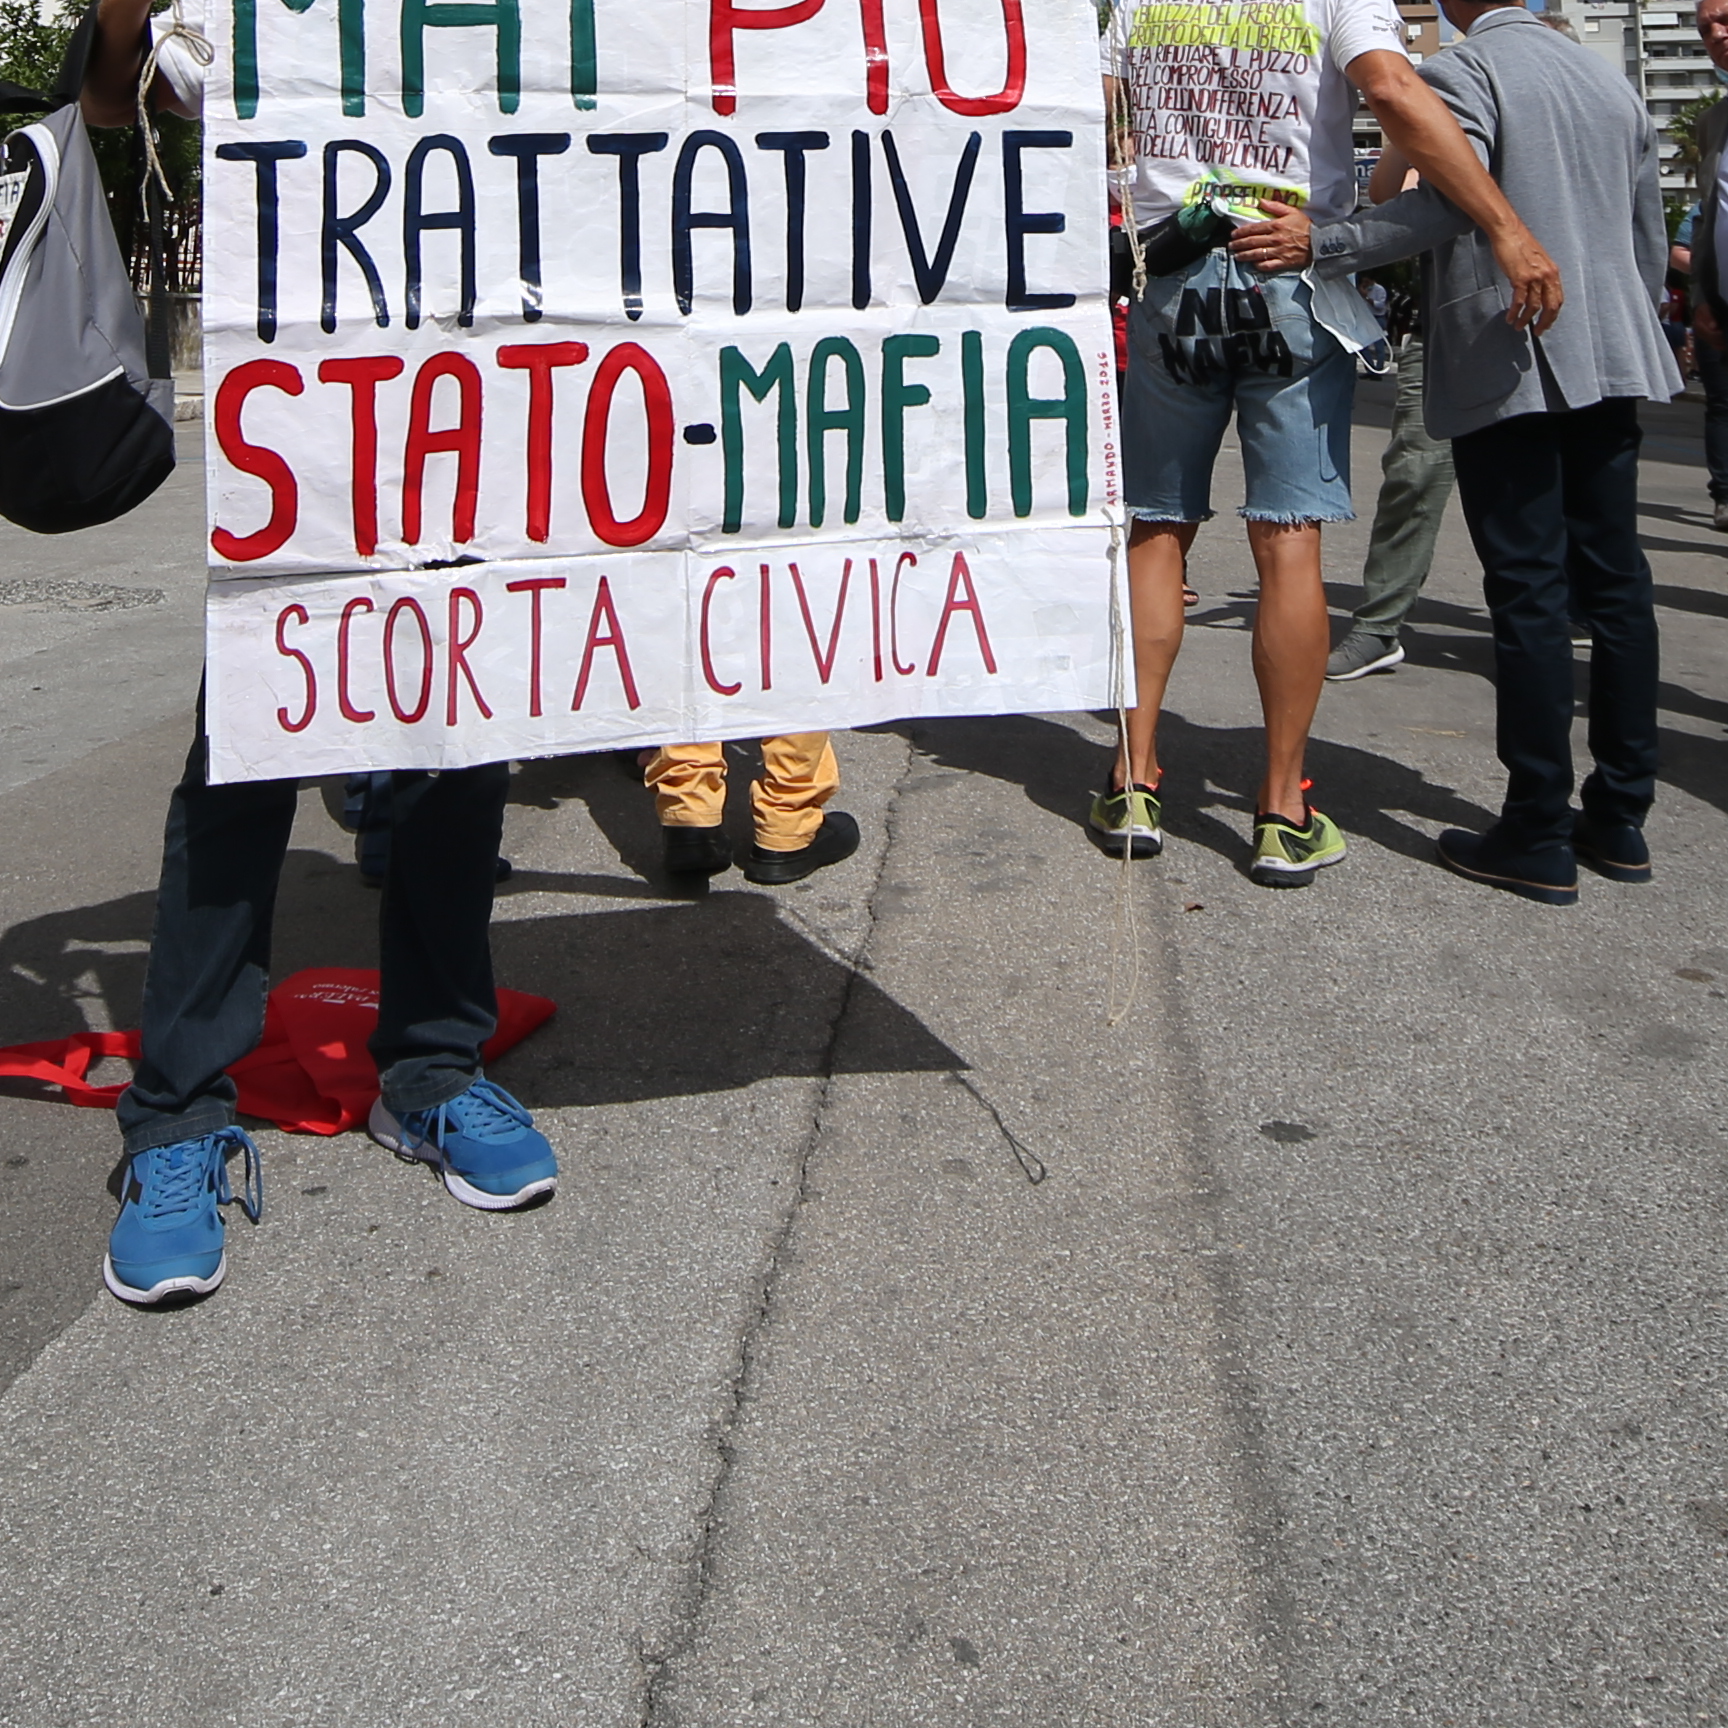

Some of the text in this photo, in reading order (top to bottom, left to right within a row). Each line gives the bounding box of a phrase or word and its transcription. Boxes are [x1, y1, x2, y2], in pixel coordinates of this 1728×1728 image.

[1139, 2, 1296, 26] BELLEZZA DEL FRESCO
[1129, 23, 1187, 46] PROFUMO
[1189, 24, 1240, 47] DELLA
[1130, 64, 1263, 90] DEL COMPROMESSO
[1154, 44, 1222, 66] RIFIUTARE
[1230, 48, 1242, 69] IL
[1250, 48, 1309, 75] PUZZO
[1143, 133, 1190, 160] DELLA
[1258, 120, 1271, 144] E
[215, 131, 1077, 344] TRATTATIVE
[1175, 284, 1272, 337] NO
[1101, 391, 1114, 431] MARZO
[211, 327, 1088, 562] STATO-MAFIA
[1103, 442, 1118, 508] ARMANDO
[276, 552, 997, 734] SCORTA CIVICA
